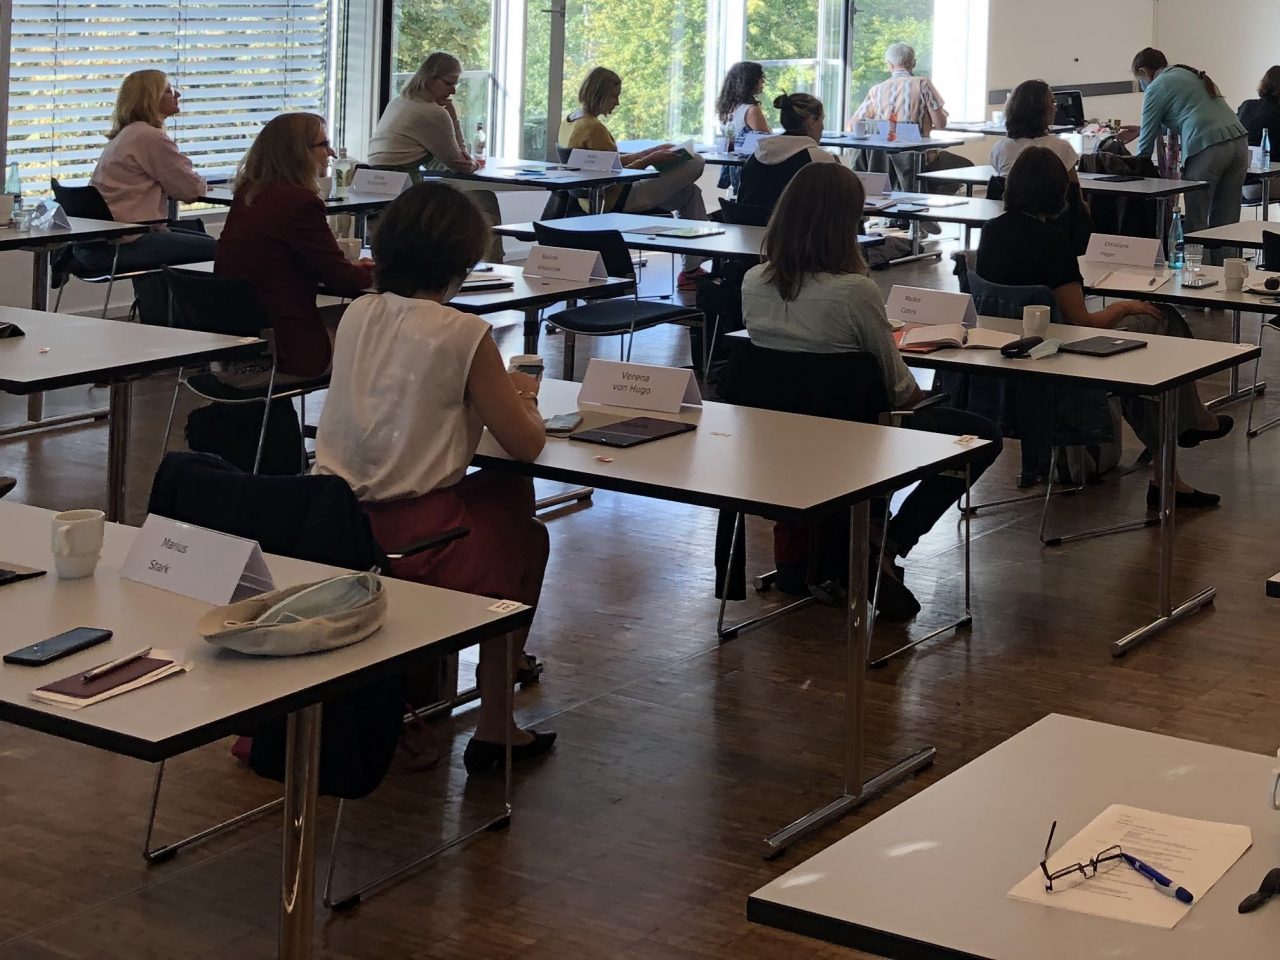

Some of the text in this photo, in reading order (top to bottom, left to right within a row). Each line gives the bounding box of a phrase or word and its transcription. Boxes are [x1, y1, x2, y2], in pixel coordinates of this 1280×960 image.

[621, 370, 650, 383] Verena
[612, 383, 652, 396] von Hugo
[160, 536, 189, 554] Marius
[148, 559, 171, 574] Stark
